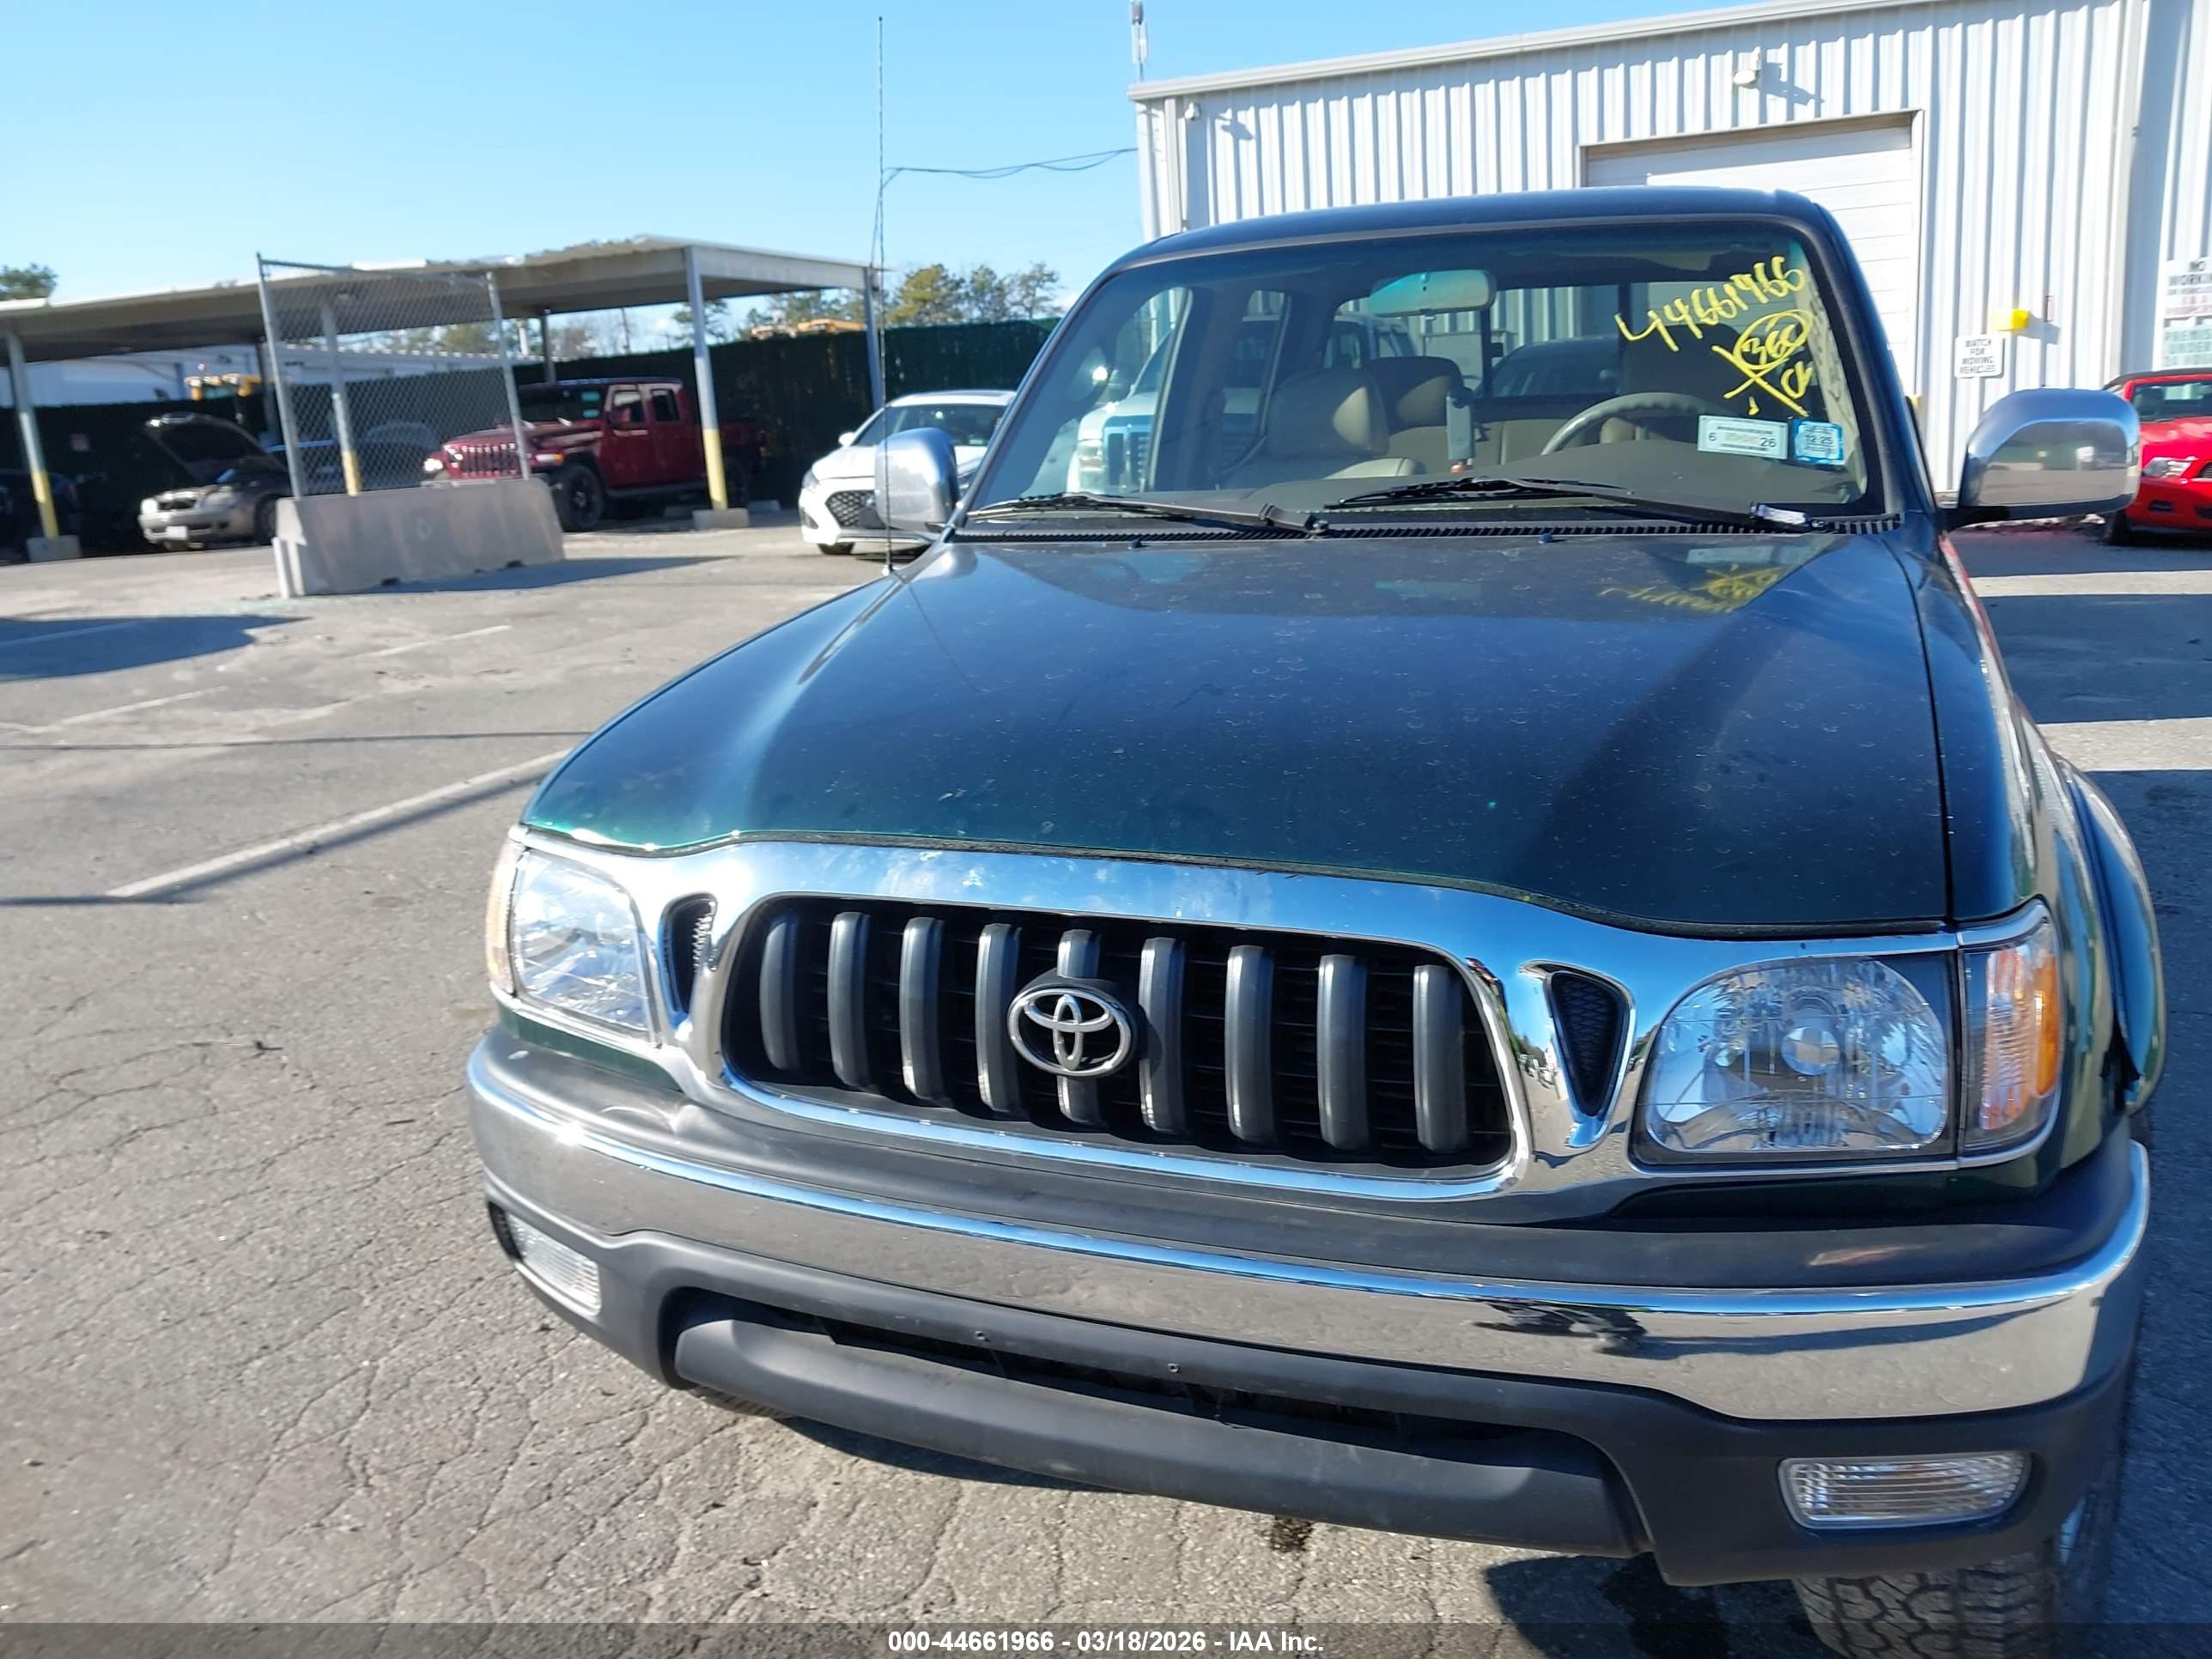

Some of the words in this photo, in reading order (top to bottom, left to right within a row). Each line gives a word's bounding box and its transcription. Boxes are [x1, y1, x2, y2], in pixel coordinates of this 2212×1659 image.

[1614, 255, 1805, 352] 44661966
[1970, 347, 1986, 356] FOR
[1708, 432, 1717, 441] 6
[1759, 437, 1778, 447] 26
